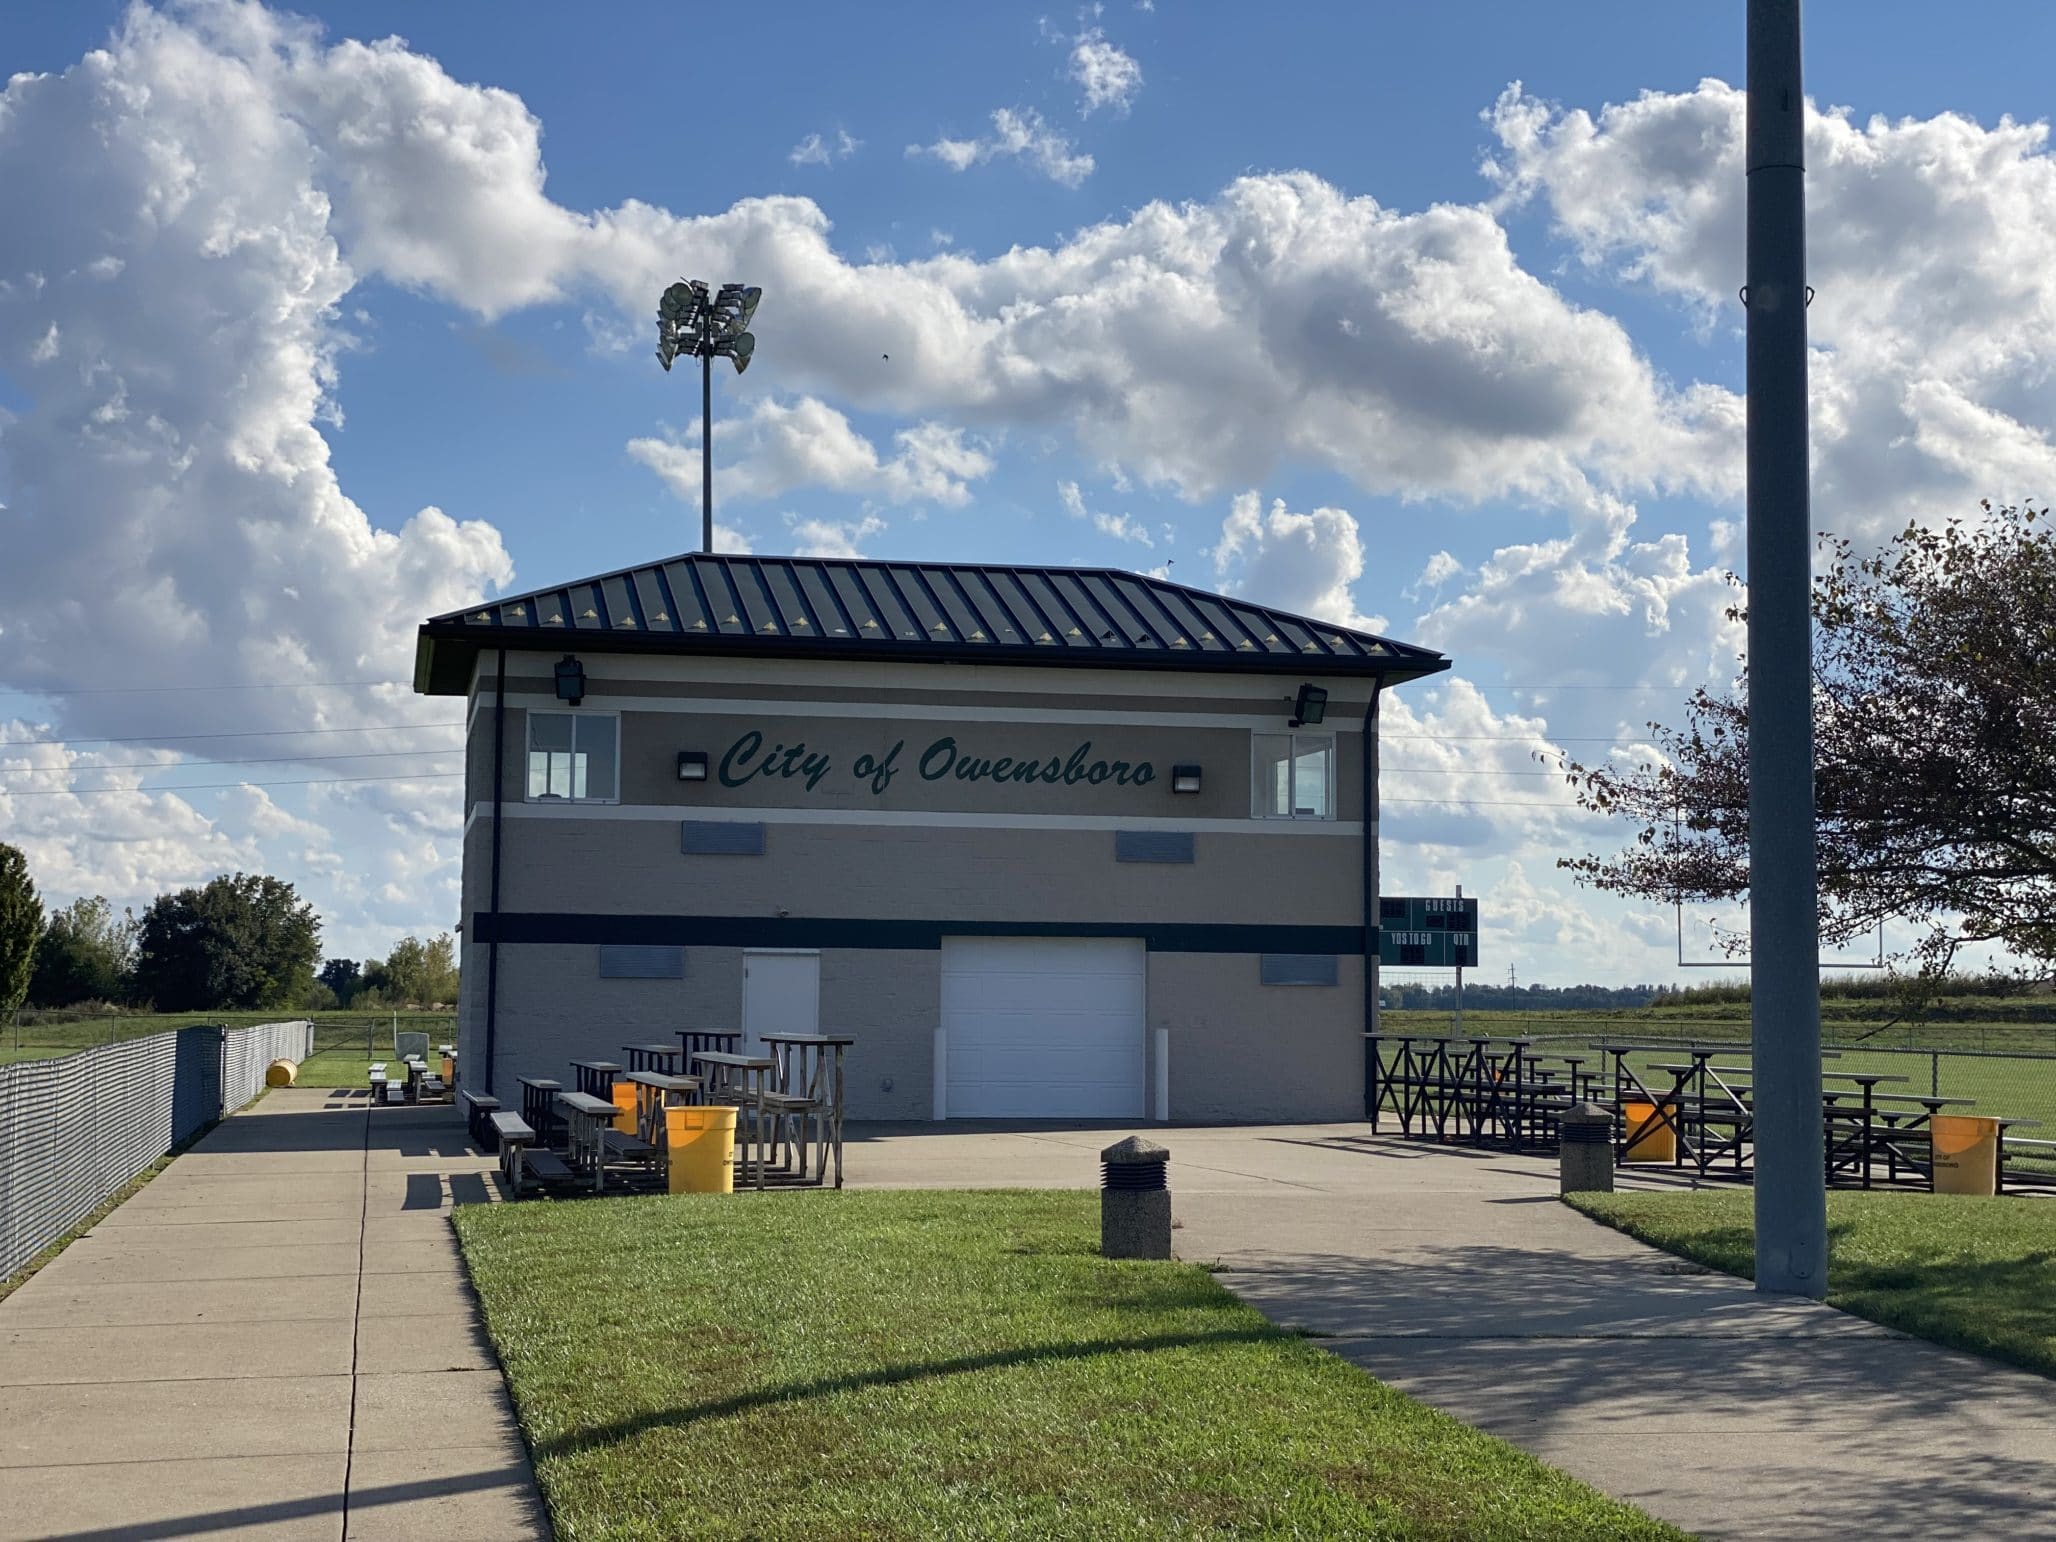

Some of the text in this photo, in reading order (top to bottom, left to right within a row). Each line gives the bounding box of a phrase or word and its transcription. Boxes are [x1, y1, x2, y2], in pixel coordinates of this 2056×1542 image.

[718, 731, 1157, 796] City of Owensboro
[1425, 900, 1464, 912] GUESTS
[1391, 933, 1432, 945] YDS TO GO
[1453, 934, 1469, 946] QTR
